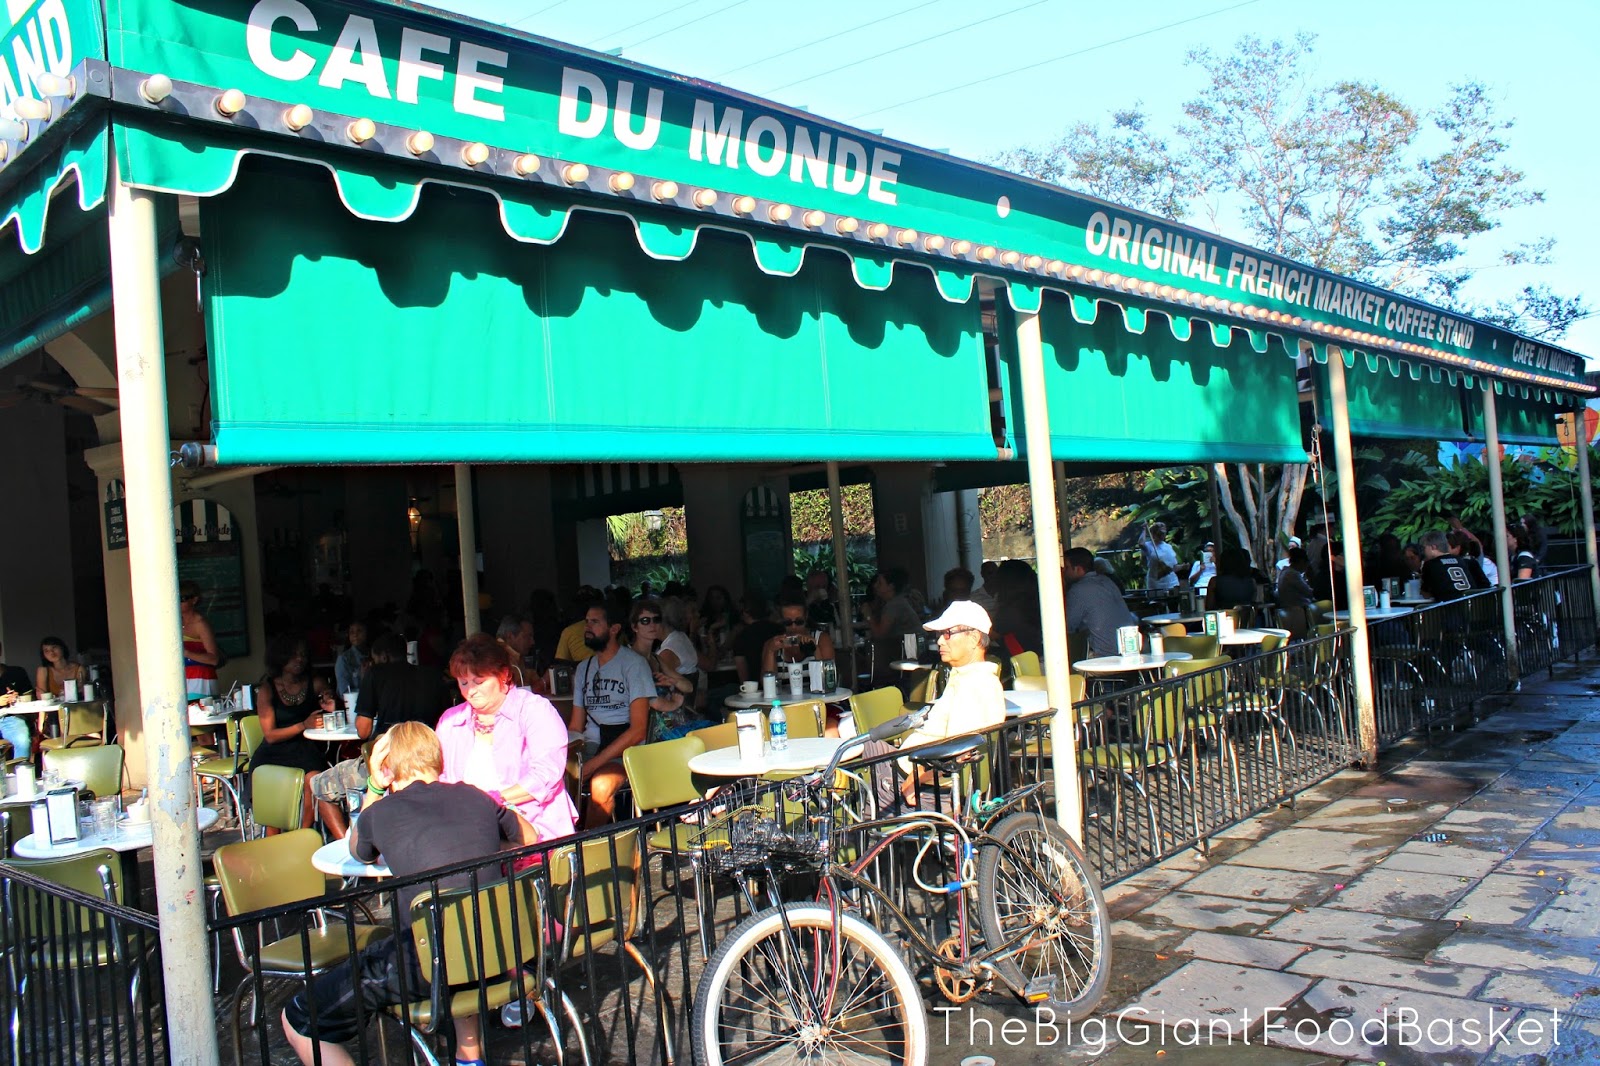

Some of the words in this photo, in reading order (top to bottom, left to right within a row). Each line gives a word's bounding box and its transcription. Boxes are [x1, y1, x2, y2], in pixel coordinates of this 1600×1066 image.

[246, 0, 509, 122] CAFE
[558, 66, 664, 151] DU
[688, 98, 902, 206] MONDE
[1085, 211, 1222, 285] ORIGINAL
[1225, 252, 1313, 307] FRENCH
[1313, 277, 1385, 325] MARKET
[1385, 302, 1437, 341] COFFEE
[1436, 315, 1475, 350] STAND
[1512, 340, 1535, 366] CAFE
[1535, 347, 1550, 370] DU
[1549, 351, 1576, 377] MONDE
[1447, 566, 1471, 591] 9
